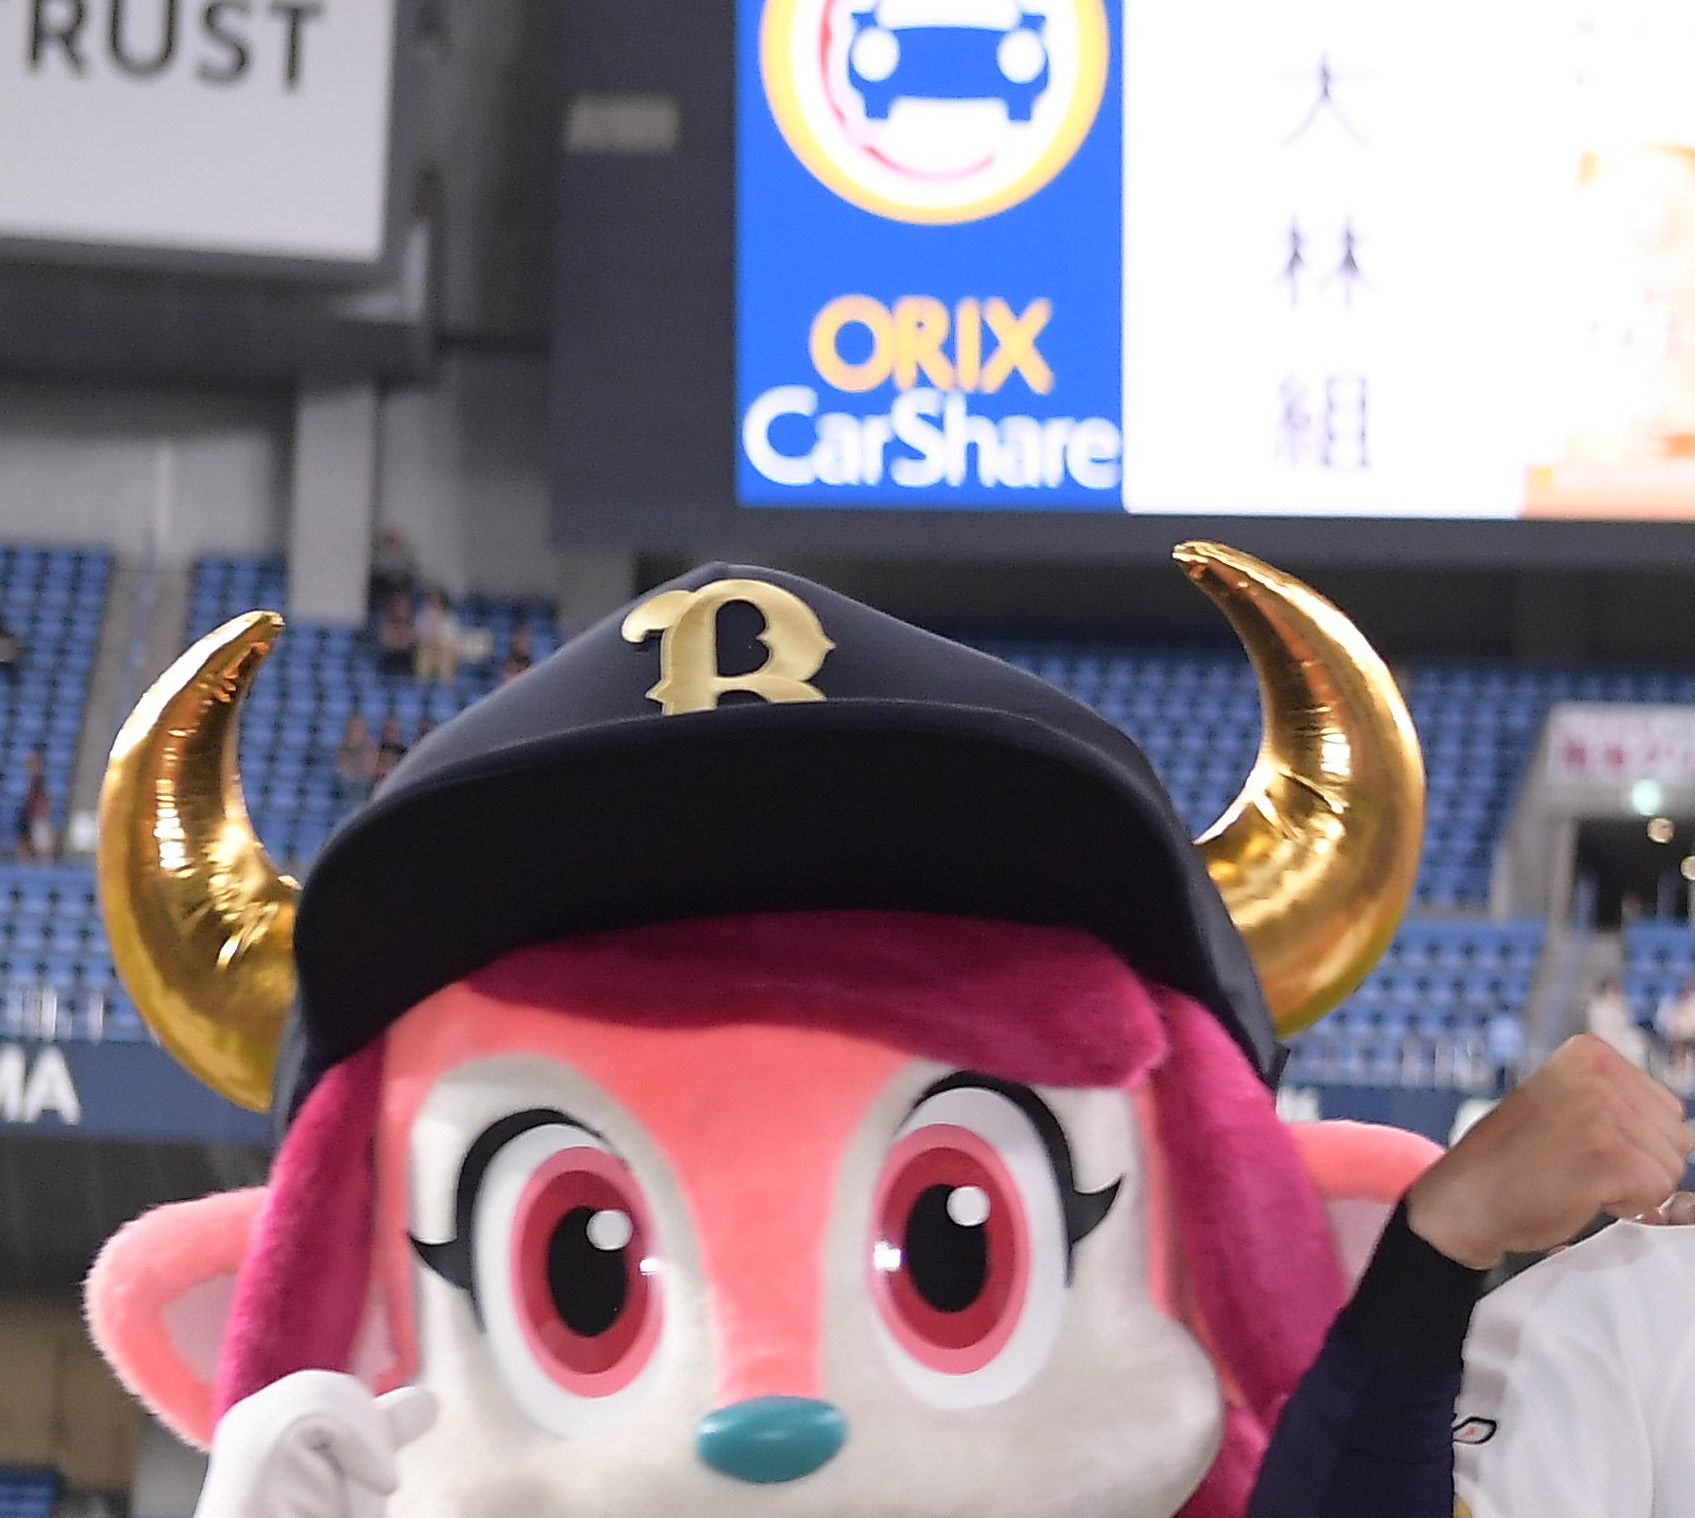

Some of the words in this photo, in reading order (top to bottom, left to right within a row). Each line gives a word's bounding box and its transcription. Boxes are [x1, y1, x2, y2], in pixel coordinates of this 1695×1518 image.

[24, 0, 330, 92] RUST
[1271, 49, 1376, 472] 大林組
[809, 293, 1055, 395] ORIX
[742, 383, 1122, 488] CarShare
